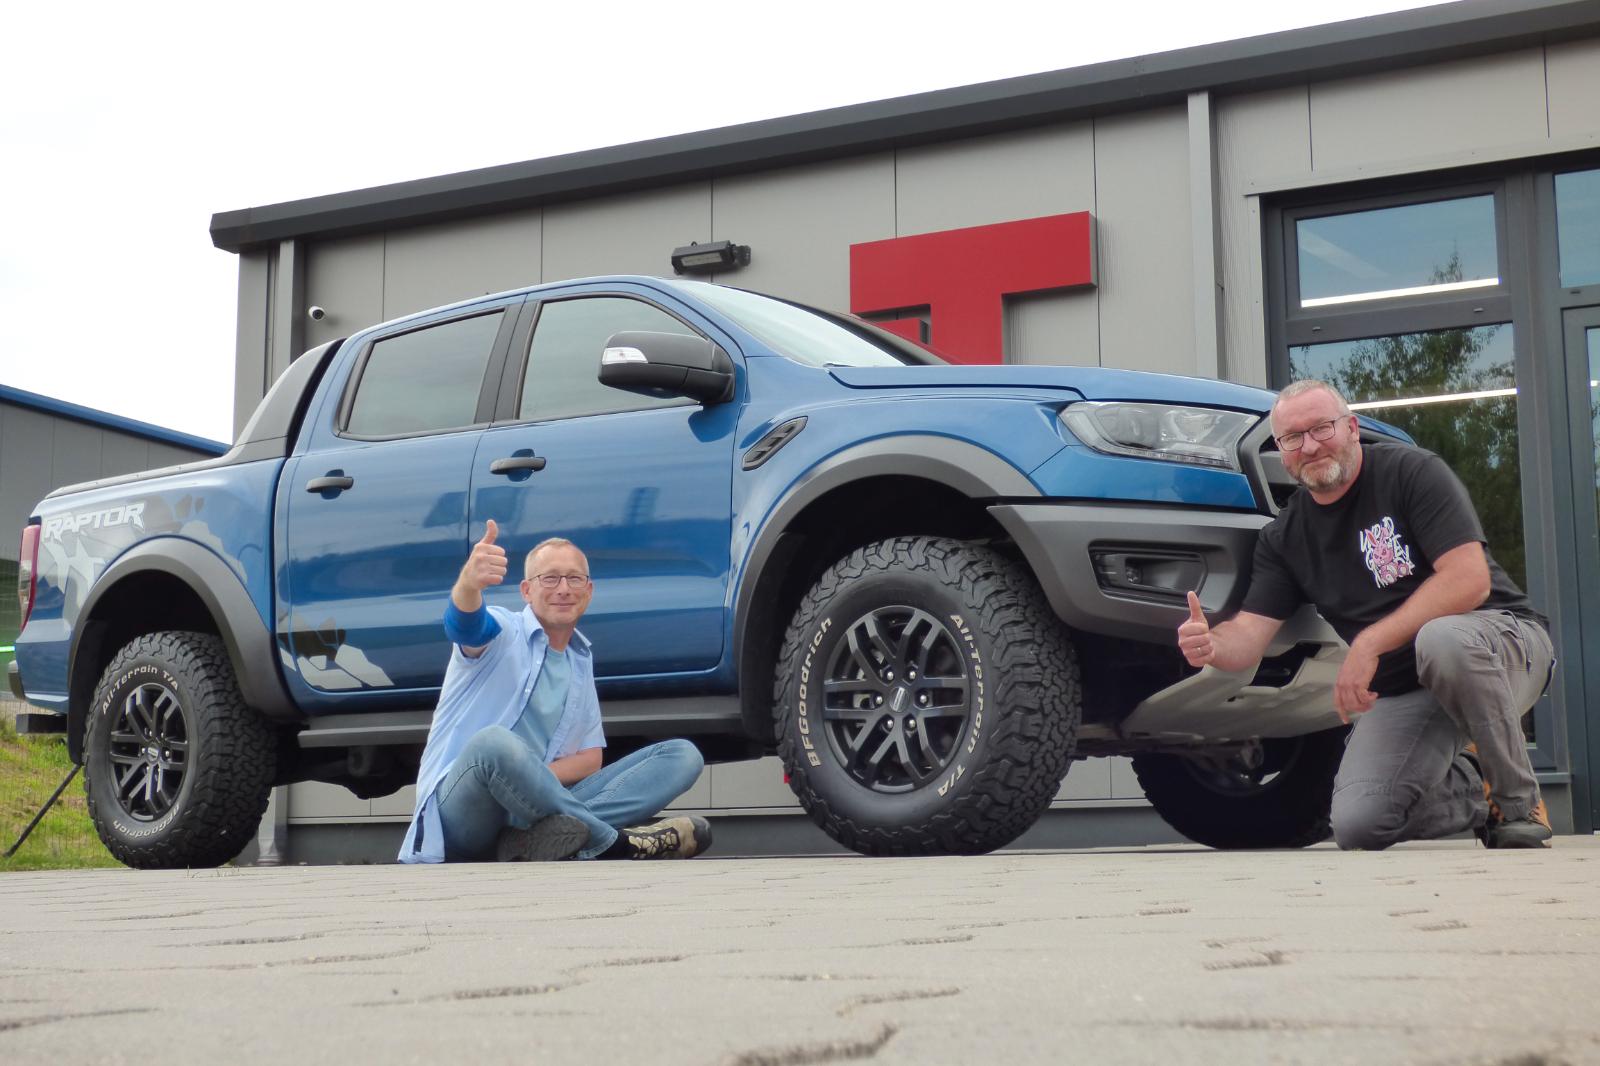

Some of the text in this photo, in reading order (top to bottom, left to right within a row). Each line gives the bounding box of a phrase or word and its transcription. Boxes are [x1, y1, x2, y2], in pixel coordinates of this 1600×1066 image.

[44, 502, 145, 541] RAPTOR
[102, 664, 178, 715] All-Terrain T/A
[799, 616, 832, 768] BFGoodrich
[937, 614, 985, 798] All-Terrain T/A
